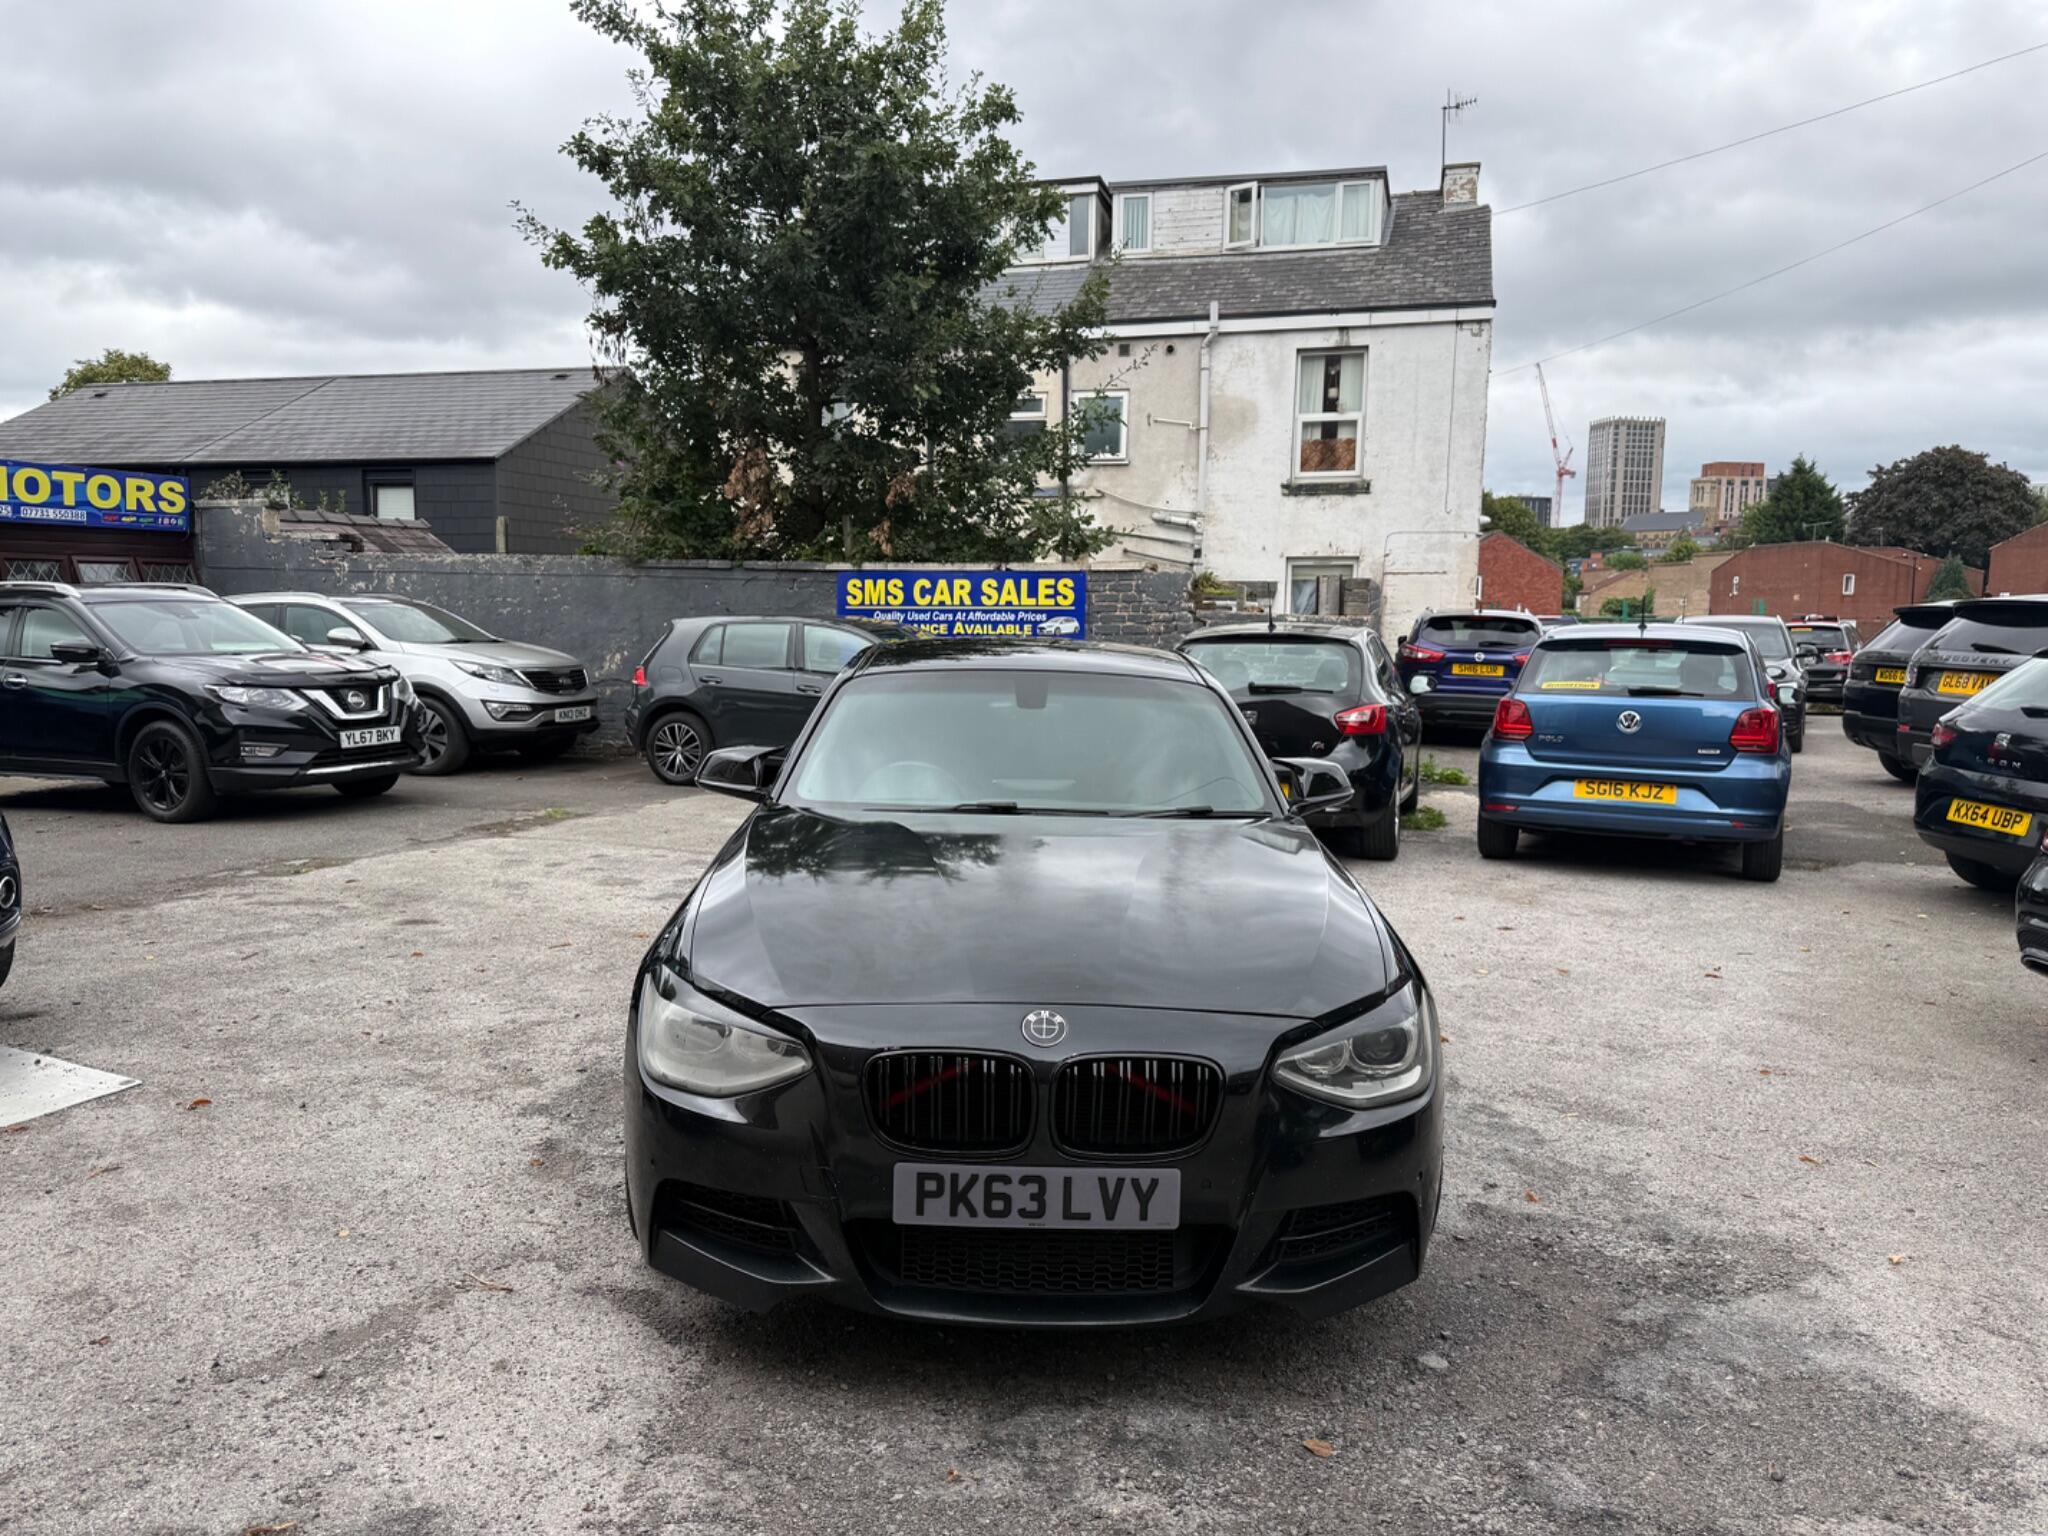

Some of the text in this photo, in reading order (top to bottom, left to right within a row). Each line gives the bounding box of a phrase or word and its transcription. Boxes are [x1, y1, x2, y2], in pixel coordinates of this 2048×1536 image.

[0, 465, 186, 514] OTORS
[846, 578, 1075, 606] SMS CAR SALES
[873, 610, 1047, 622] Quality Used Cars At Affordable Prices
[953, 621, 1032, 635] AVAILABLE
[1942, 675, 1968, 689] GL68
[344, 728, 395, 746] YL67 BKY
[1585, 780, 1664, 800] SG16 KJZ
[1953, 802, 2023, 830] KX64 UBP
[915, 1171, 1160, 1222] PK63 LVY
